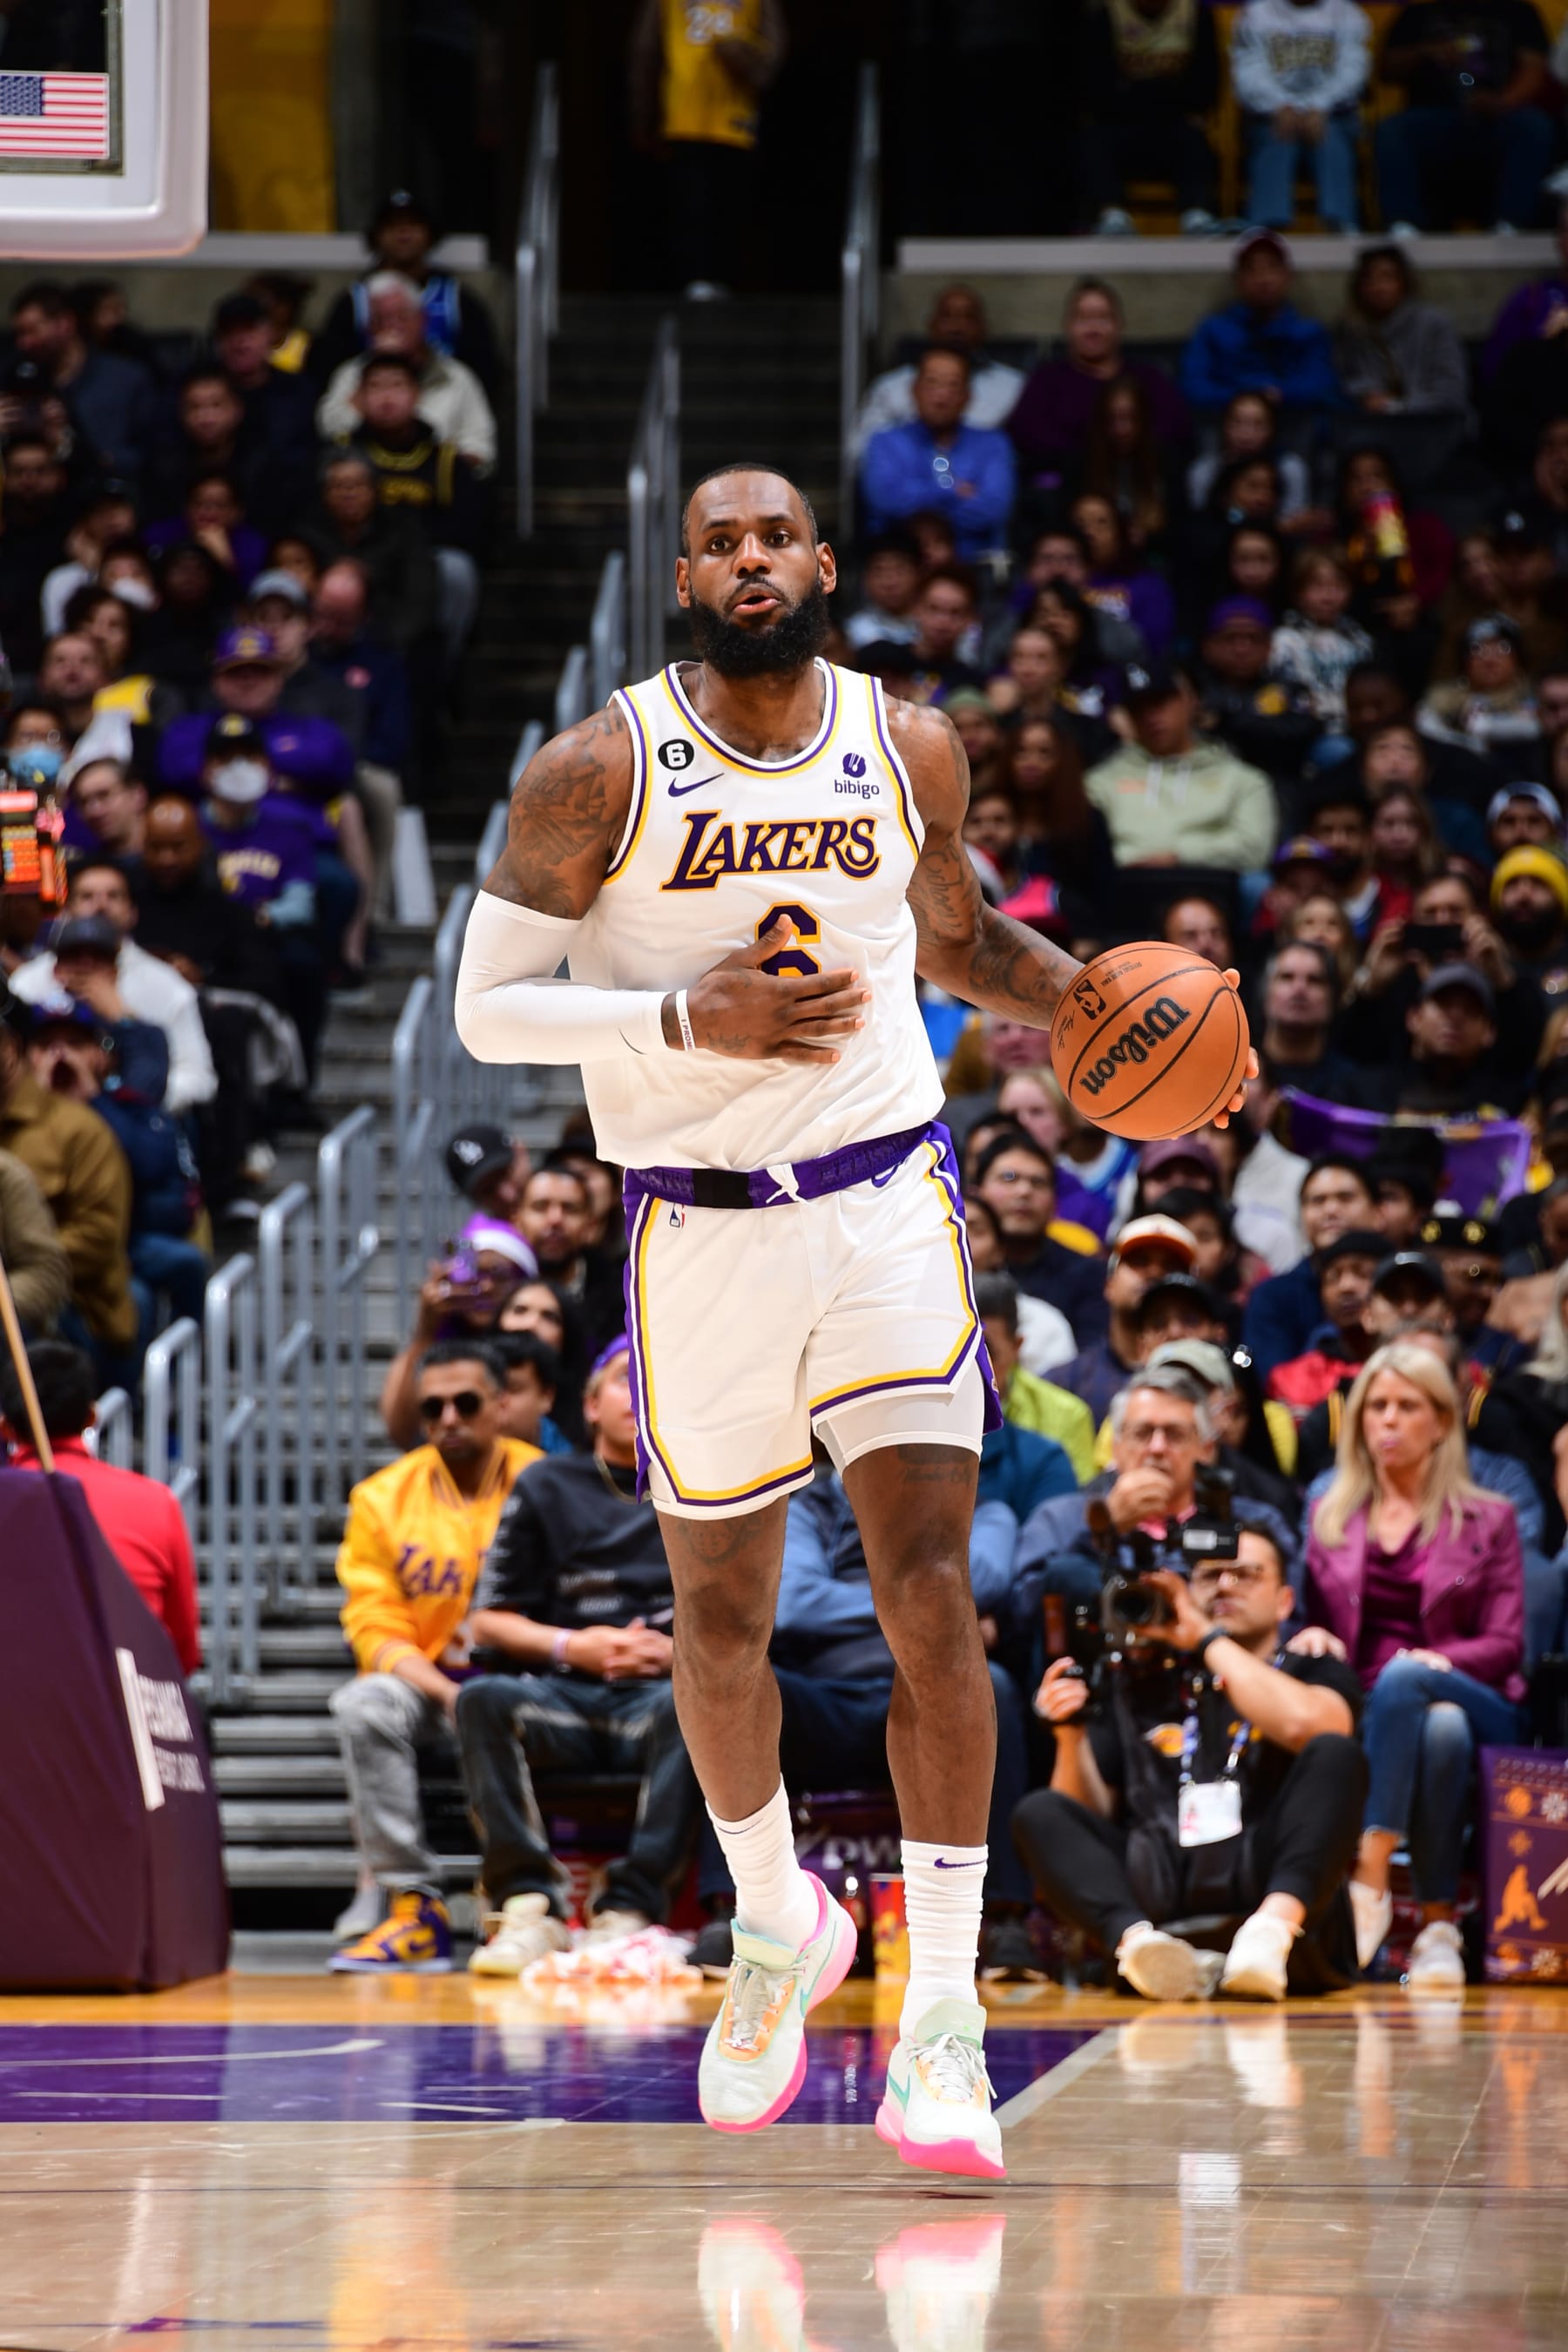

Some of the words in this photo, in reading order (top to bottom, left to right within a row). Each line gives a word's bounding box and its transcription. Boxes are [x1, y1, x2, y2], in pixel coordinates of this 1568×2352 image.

[666, 742, 686, 767] 6
[834, 779, 880, 800] bibigo
[659, 810, 882, 892] LAKERS
[754, 901, 822, 977] 6
[1079, 996, 1191, 1096] Wilson
